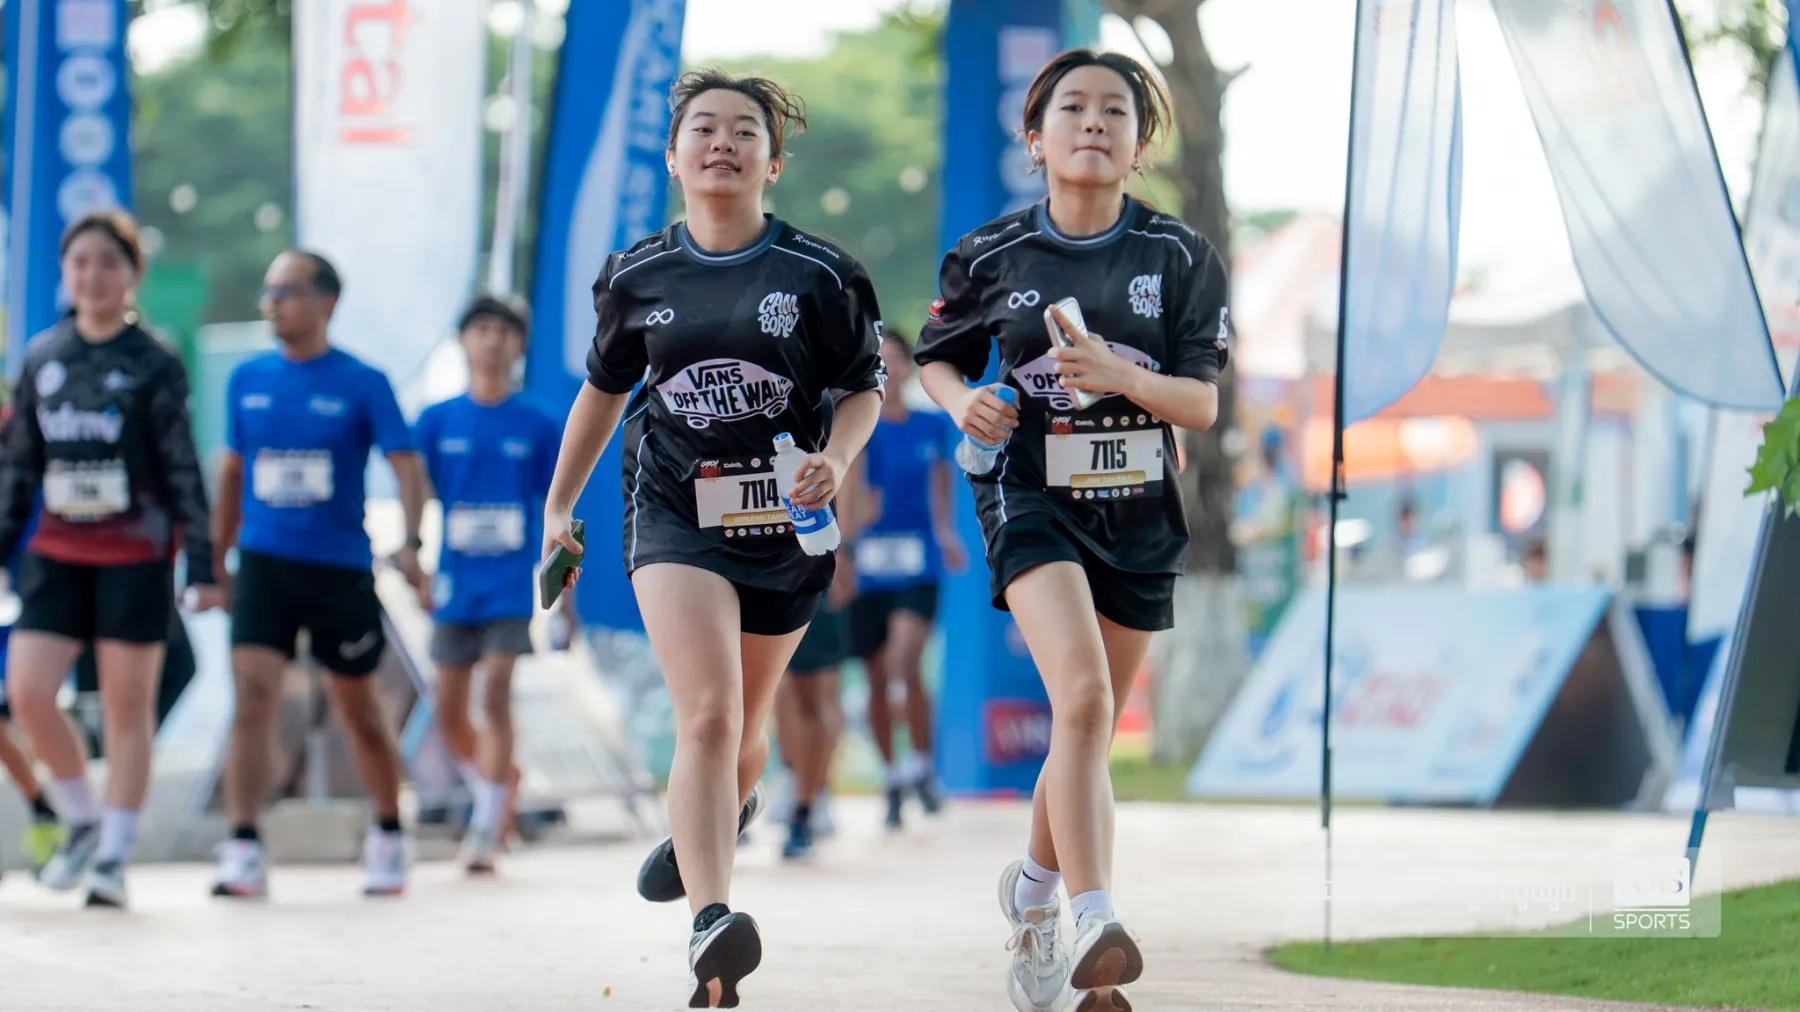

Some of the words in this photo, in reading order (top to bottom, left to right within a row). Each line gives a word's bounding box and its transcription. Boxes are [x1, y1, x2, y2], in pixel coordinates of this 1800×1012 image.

[758, 292, 799, 315] CAM
[686, 361, 744, 390] VANS
[667, 389, 699, 410] "OFF
[698, 374, 742, 415] THE
[1090, 438, 1127, 471] 7115
[739, 478, 779, 510] 7114
